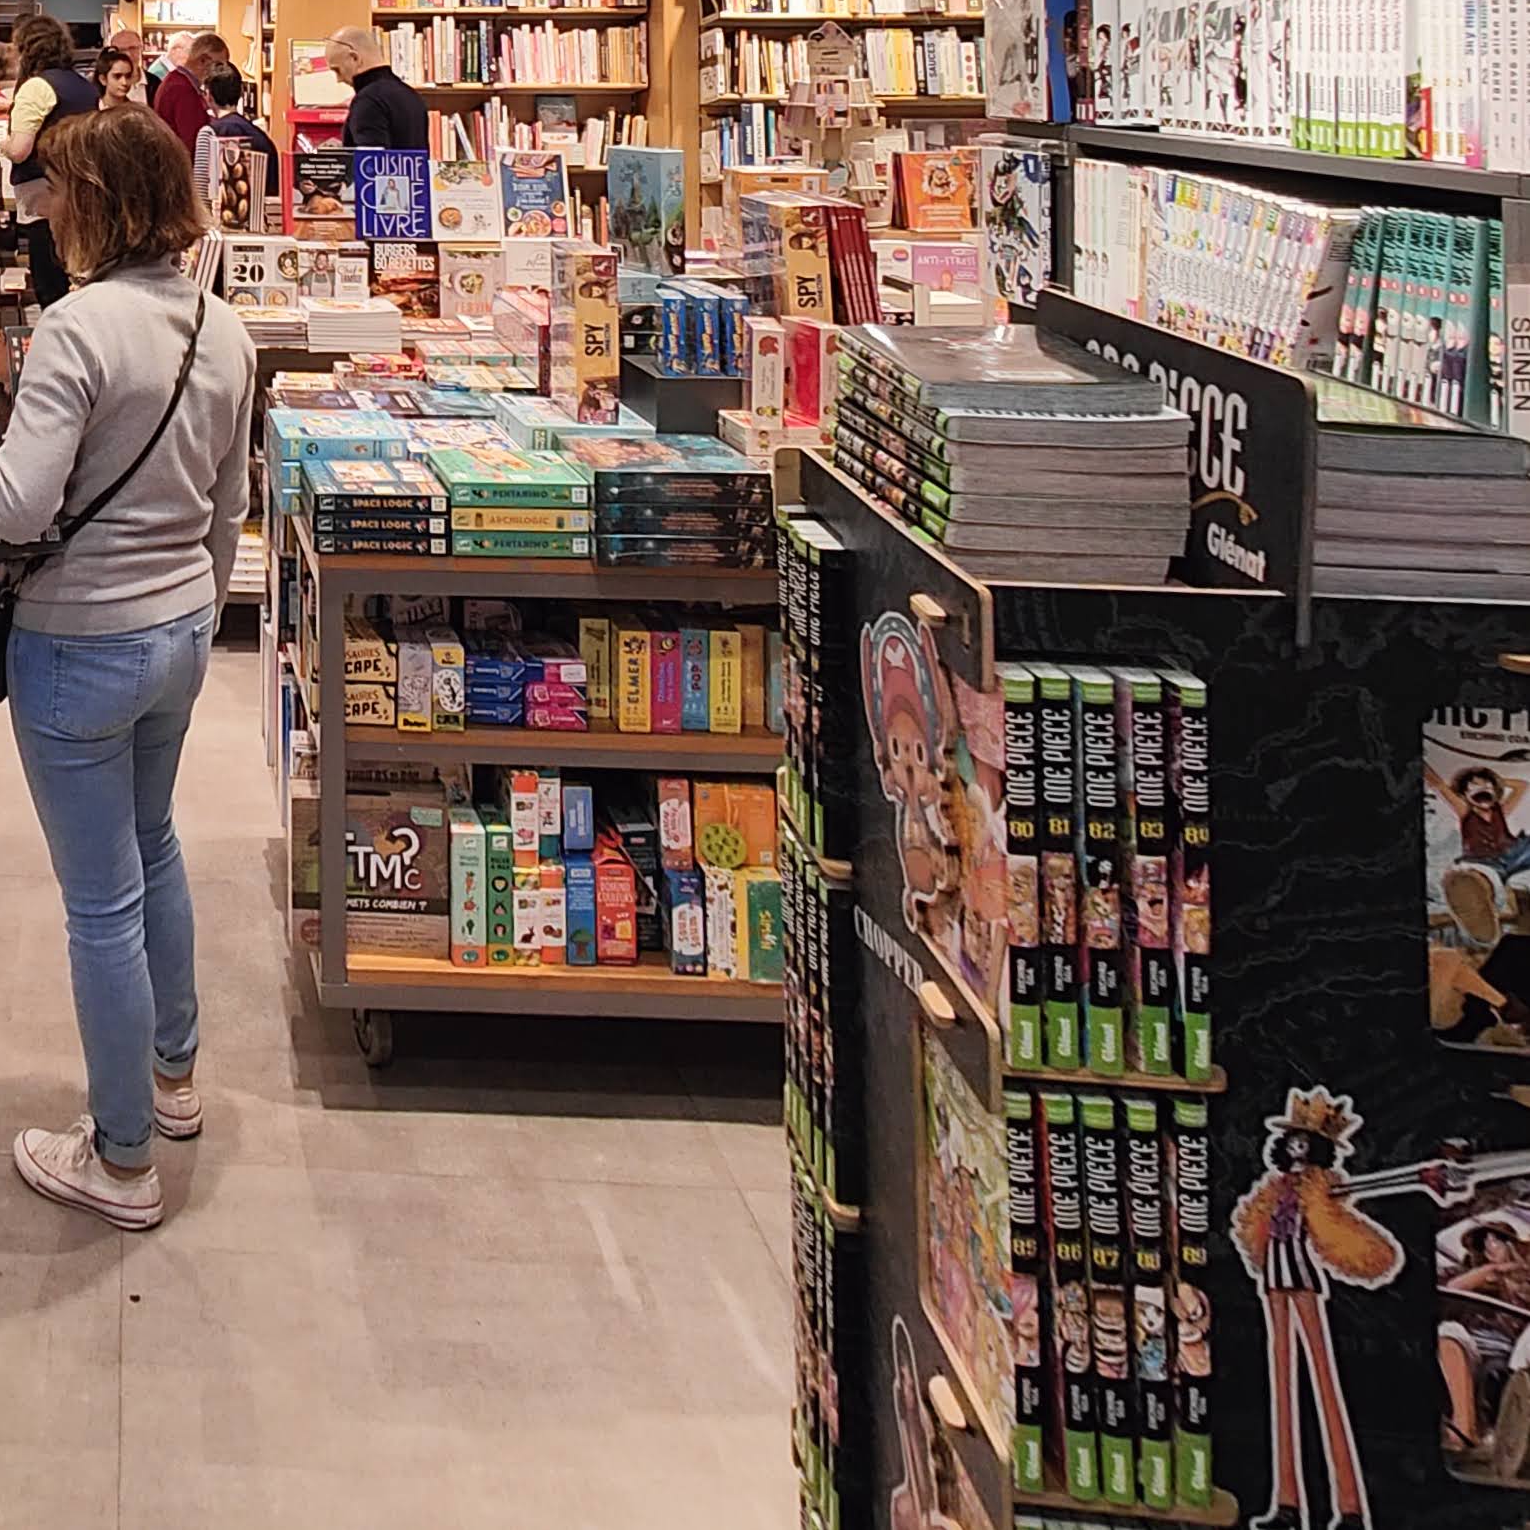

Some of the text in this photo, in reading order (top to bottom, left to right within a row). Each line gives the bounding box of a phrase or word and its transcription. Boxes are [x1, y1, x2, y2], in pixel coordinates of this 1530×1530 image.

[928, 42, 937, 77] SAUCES
[360, 156, 425, 181] CUISINE
[362, 206, 426, 237] LIVRE
[374, 243, 417, 256] BURGERS
[374, 257, 435, 271] 60 RECETTES
[233, 264, 265, 283] 20
[797, 275, 817, 308] SPY
[585, 322, 604, 356] SPY
[1511, 317, 1530, 411] SEINEN
[352, 498, 413, 509] SPACE LOGIC
[350, 519, 412, 531] SPACE LOGIC
[352, 540, 413, 551] SPACE LOGIC
[1207, 522, 1266, 583] Glénat
[345, 648, 381, 660] SAURES
[345, 659, 382, 674] CAPE
[345, 690, 379, 701] SAURES
[628, 657, 639, 703] ELMER
[344, 702, 380, 717] CAPE
[1005, 711, 1036, 806] ONE PIECE
[1042, 708, 1072, 803] ONE PIECE
[1084, 712, 1116, 808] ONE PIECE
[1134, 711, 1165, 806] ONE PIECE
[1181, 717, 1209, 812] ONE PIECE
[372, 899, 416, 910] COMBIEN
[1007, 1128, 1036, 1224] ONE PIECE
[1048, 1132, 1081, 1229] ONE PIECE
[1085, 1136, 1120, 1234] ONE PIECE
[1127, 1139, 1162, 1237] ONE PIECE
[1178, 1135, 1209, 1233] ONE PIECE
